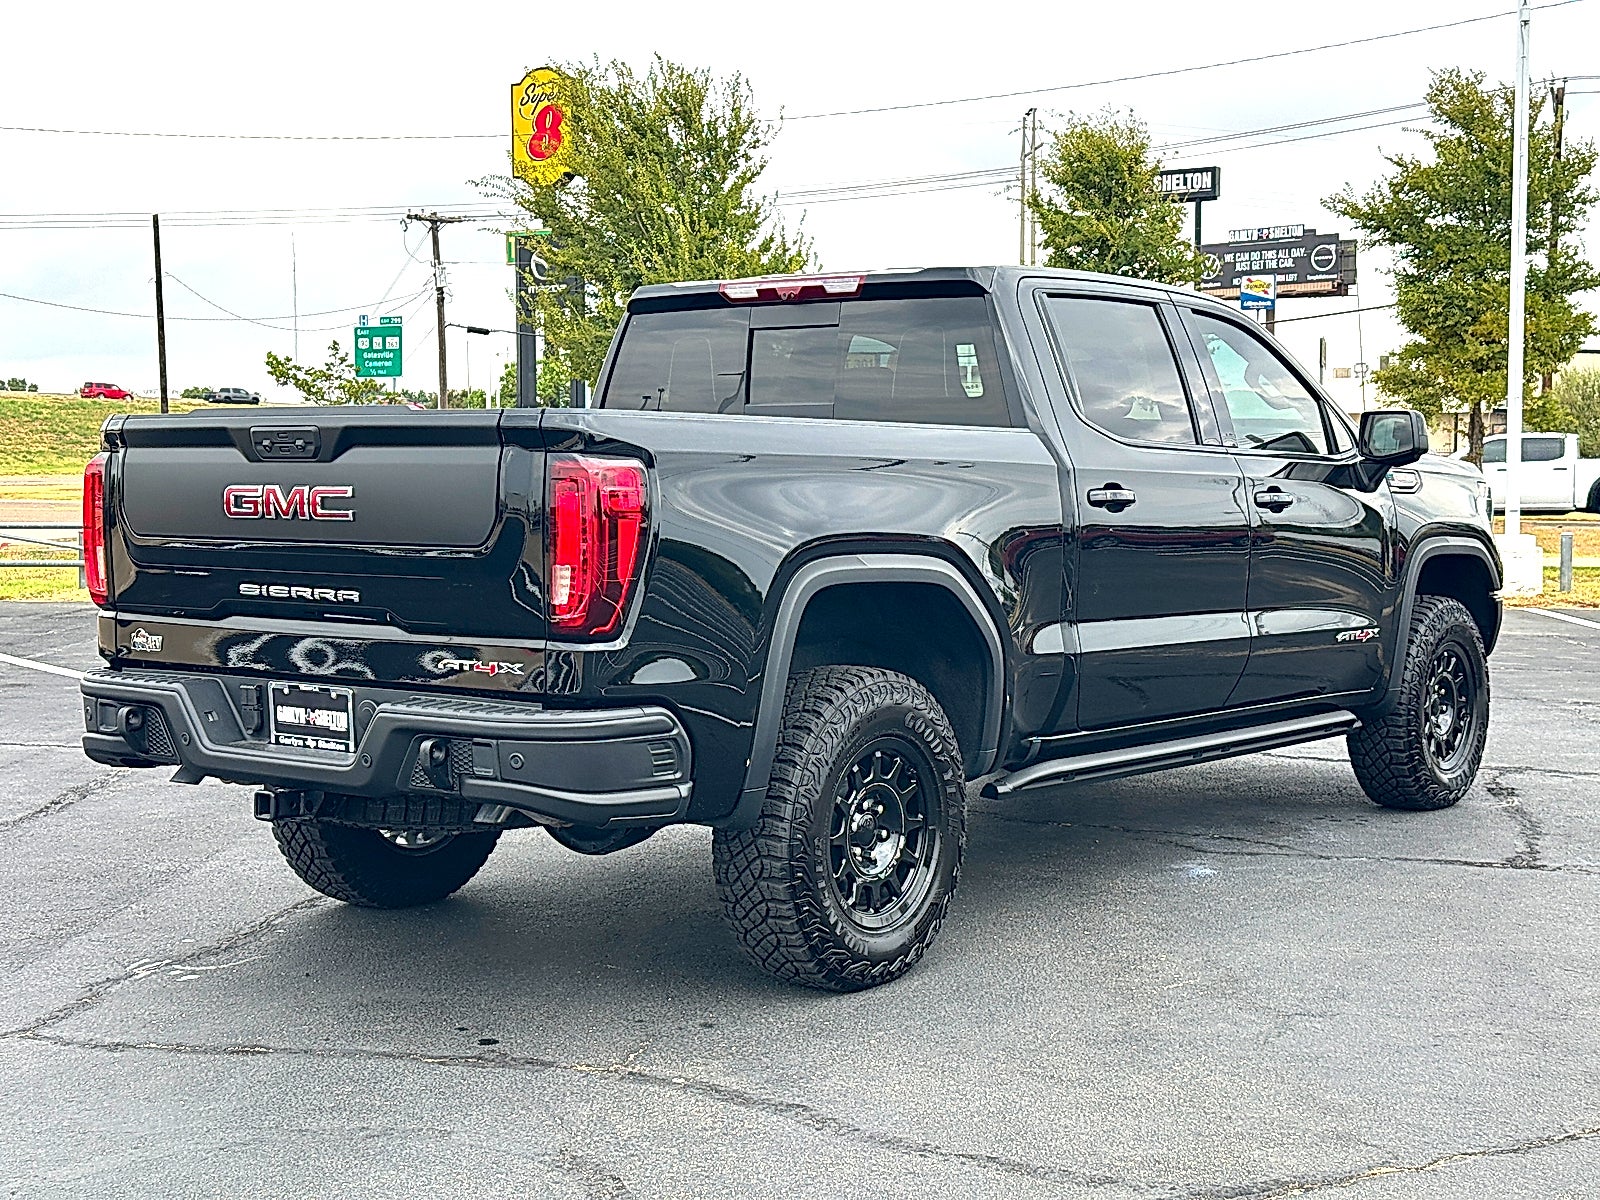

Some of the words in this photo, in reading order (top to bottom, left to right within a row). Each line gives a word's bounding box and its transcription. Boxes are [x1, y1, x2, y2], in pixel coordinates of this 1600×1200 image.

[526, 103, 563, 161] 8
[1154, 171, 1212, 192] SHELTON
[1269, 225, 1304, 239] SHELTON
[1224, 252, 1235, 263] WE
[1235, 251, 1250, 262] CAN
[1250, 250, 1260, 261] DO
[1261, 249, 1278, 260] THIS
[1278, 248, 1290, 259] ALL
[1291, 247, 1307, 258] DAY.
[1235, 261, 1251, 272] JUST
[1251, 260, 1264, 270] GET
[1265, 259, 1278, 270] THE
[1286, 273, 1298, 281] LEFT
[223, 484, 354, 521] GMC
[239, 583, 360, 603] SIERRA
[1335, 628, 1380, 642] AT4X
[437, 659, 525, 677] AT4X
[314, 708, 348, 730] SHELTON
